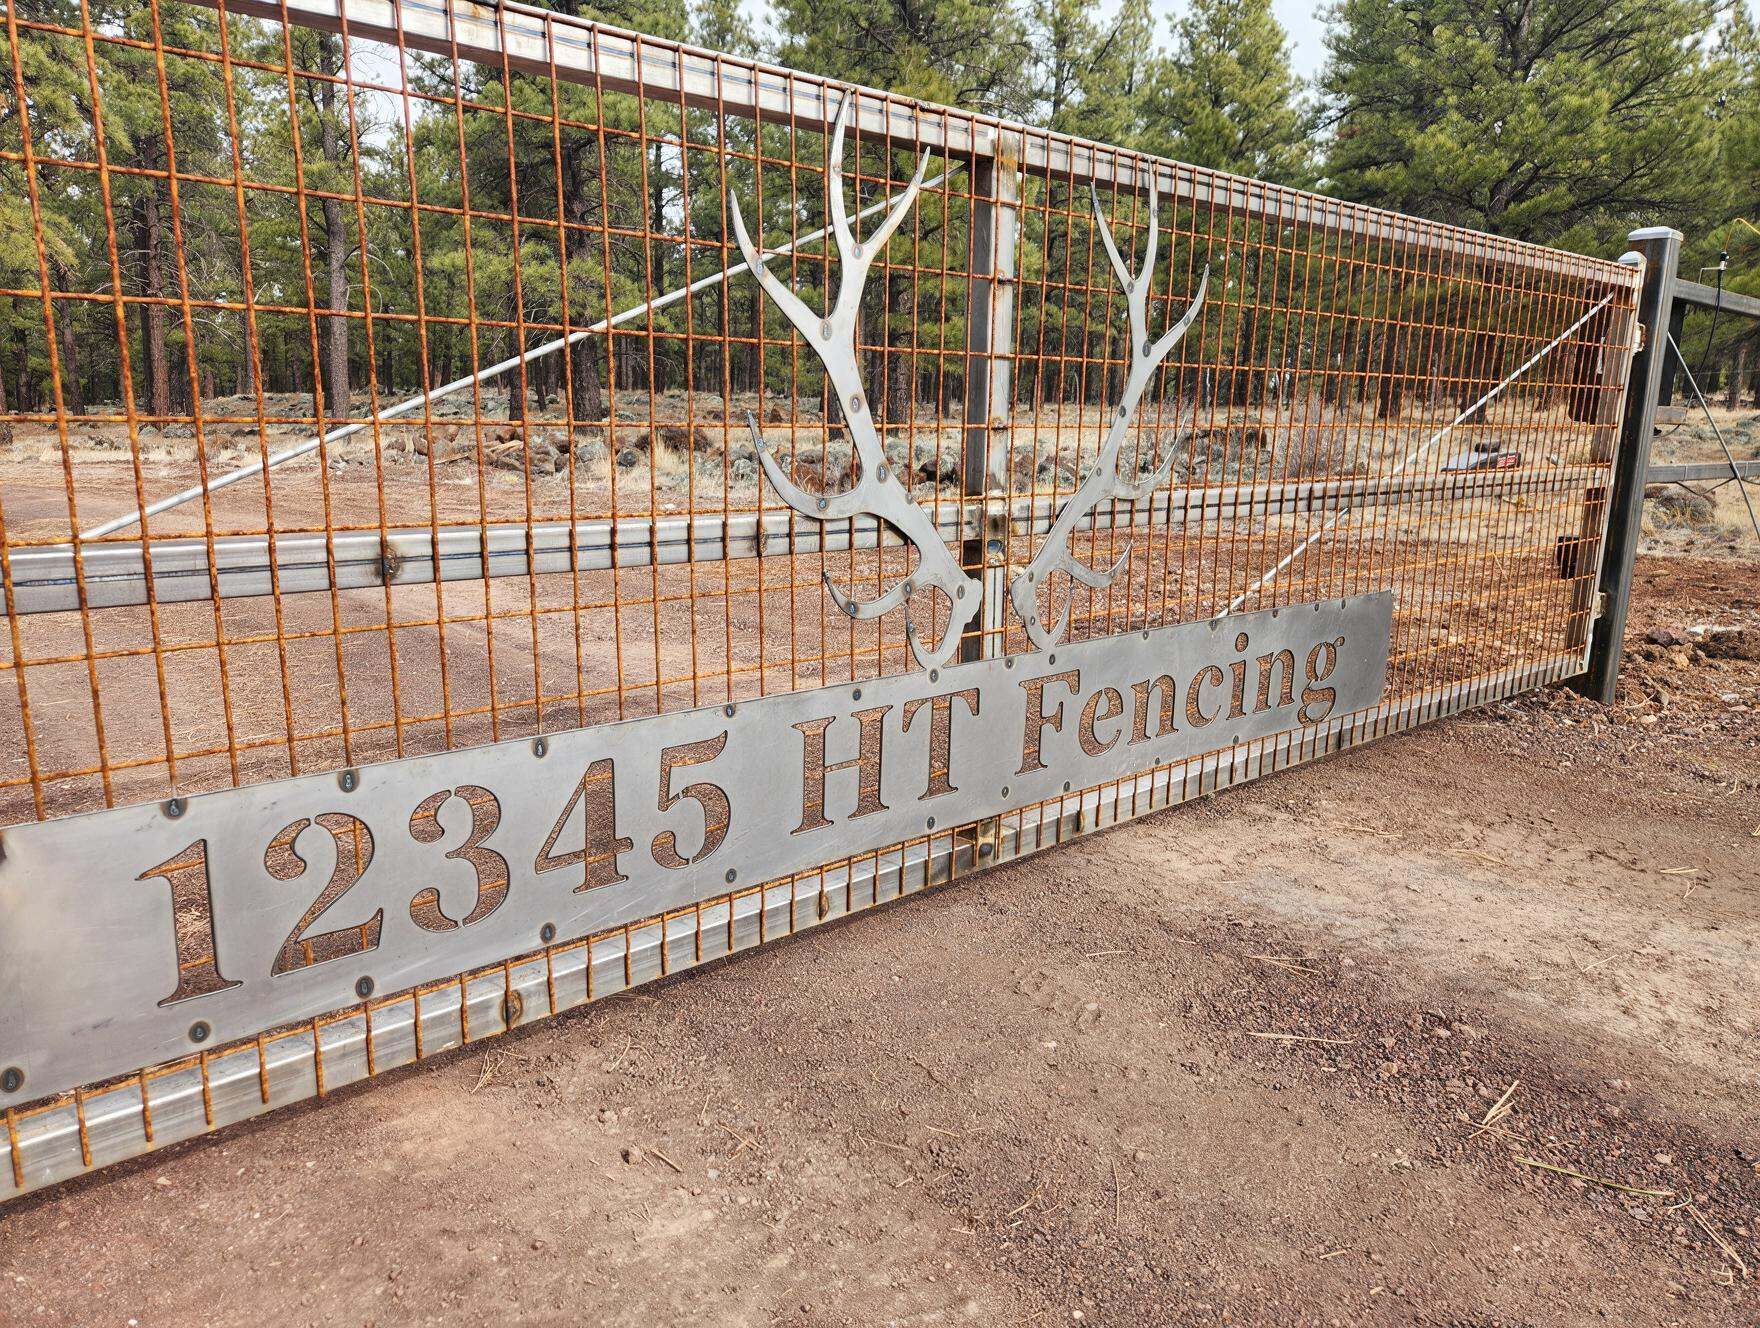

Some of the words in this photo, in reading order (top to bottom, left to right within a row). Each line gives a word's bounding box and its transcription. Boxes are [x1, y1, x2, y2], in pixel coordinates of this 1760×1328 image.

[134, 729, 733, 1008] 12345
[790, 687, 981, 836] HT
[1014, 631, 1346, 778] Fencing
